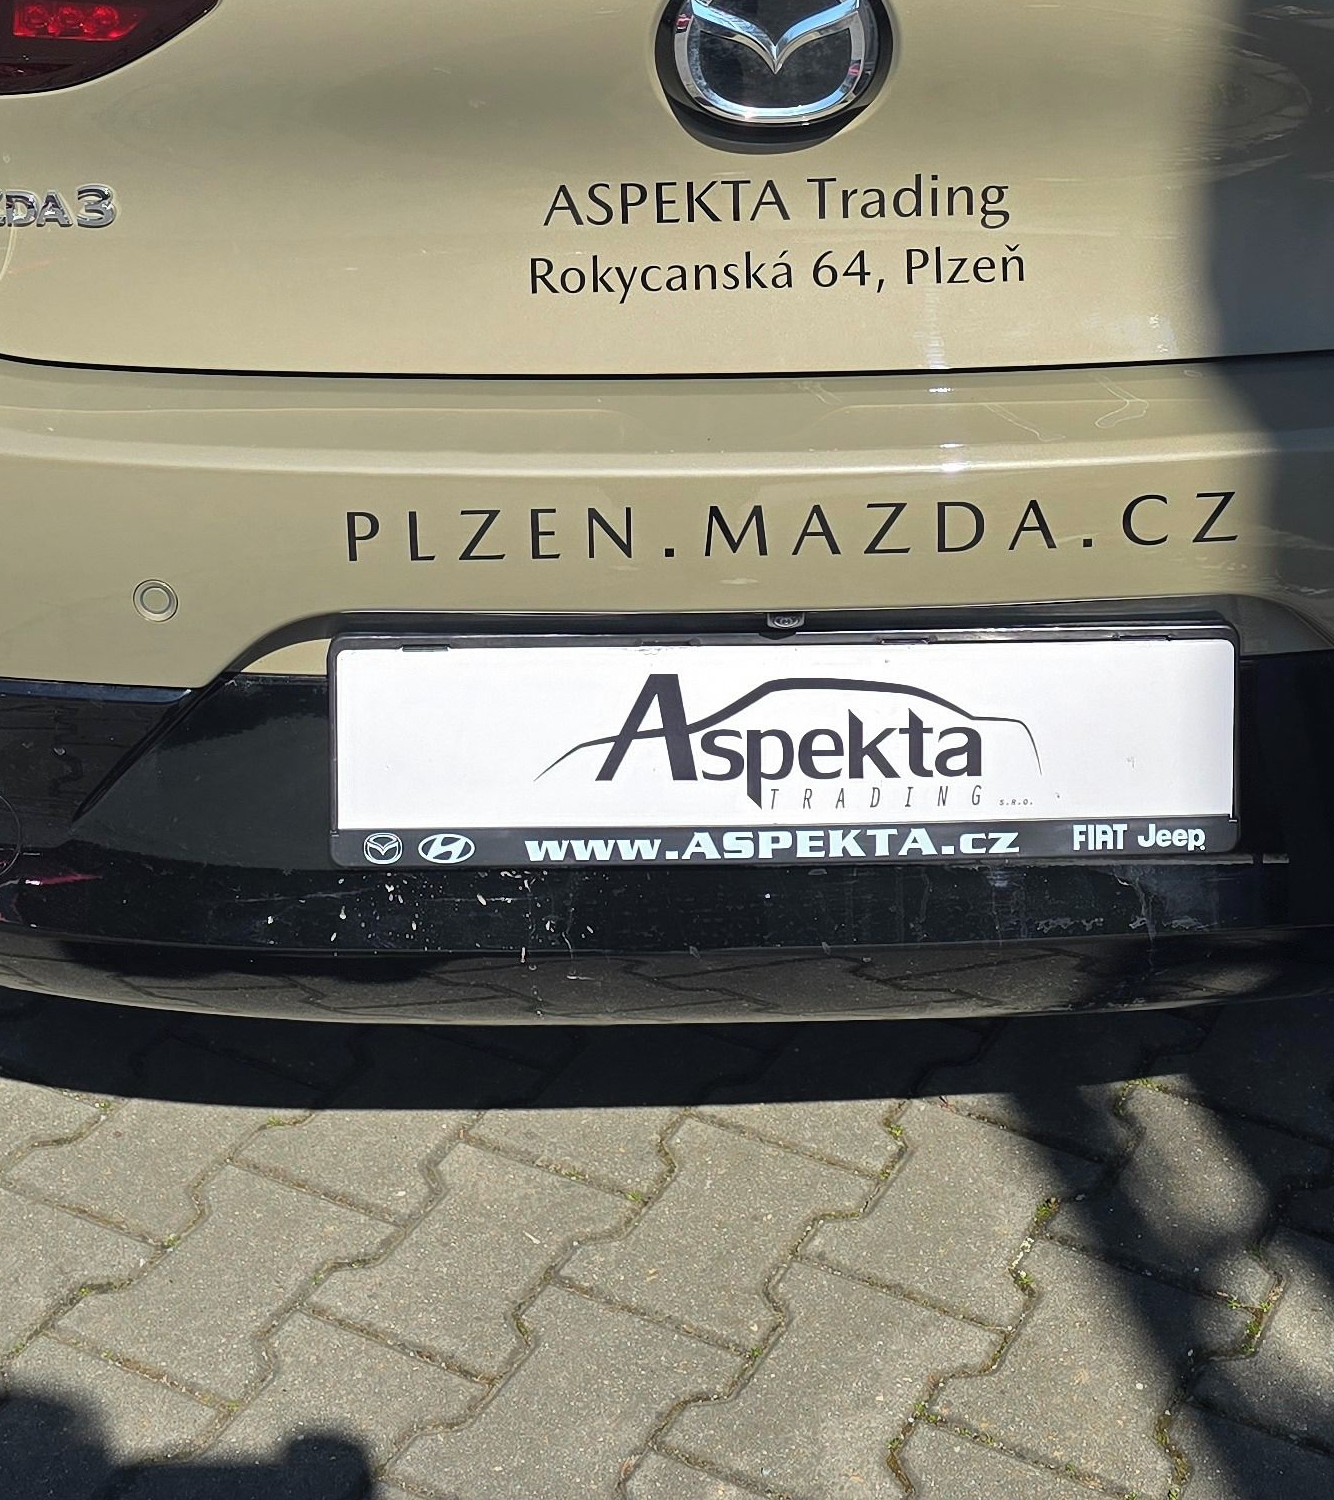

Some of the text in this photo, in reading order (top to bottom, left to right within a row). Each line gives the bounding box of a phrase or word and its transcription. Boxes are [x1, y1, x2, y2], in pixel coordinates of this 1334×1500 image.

[543, 173, 1011, 230] ASPEKTA Trading
[529, 244, 1025, 304] Rokycanská 64, Plzeň
[345, 491, 1240, 562] PLZEN.MAZDA.CZ
[595, 673, 984, 809] Aspekta
[768, 784, 984, 810] TRADING
[524, 827, 1020, 861] www.ASPEKTA.cz
[1073, 823, 1128, 851] FIAT
